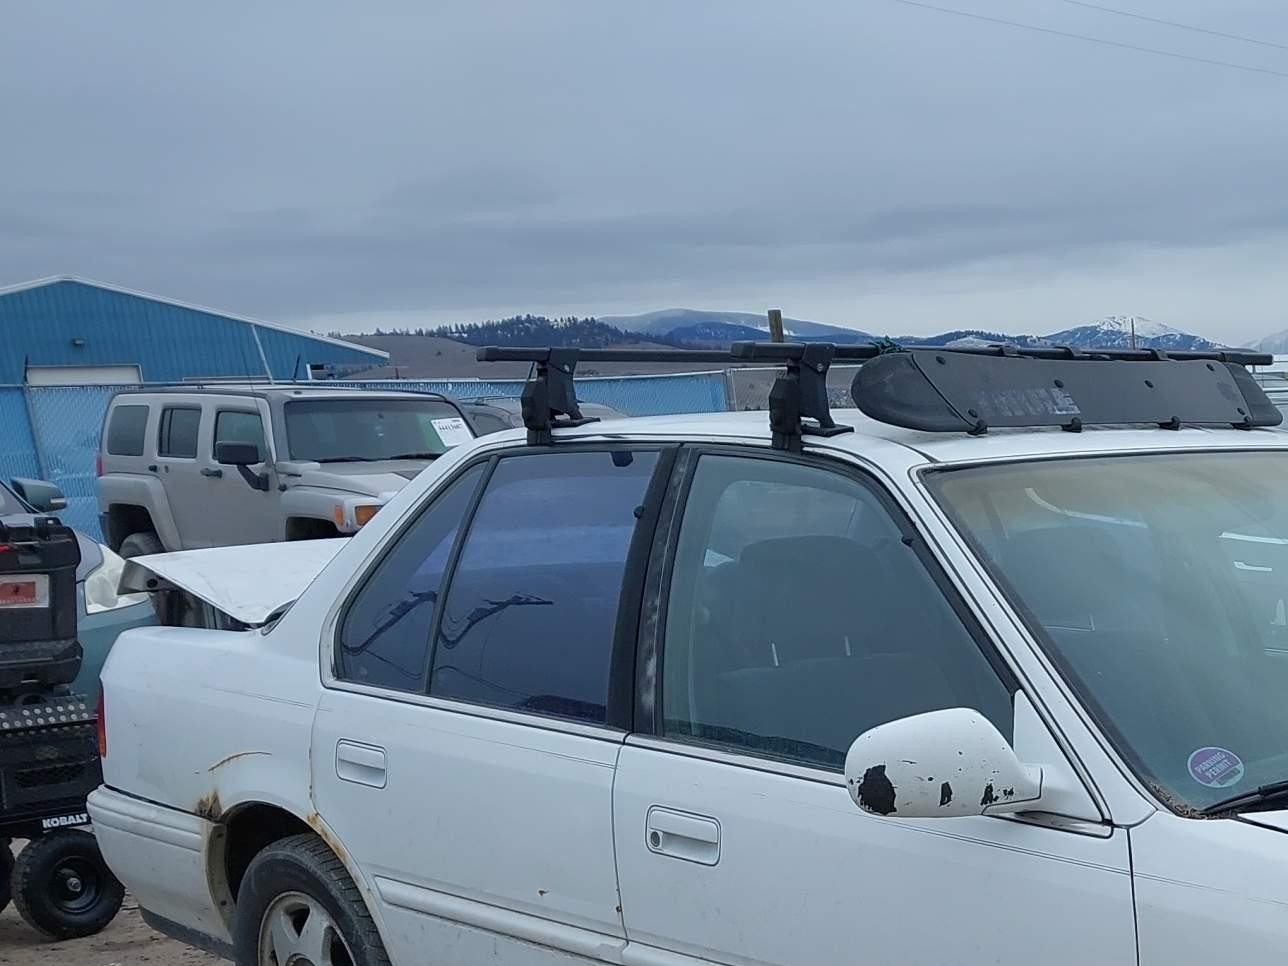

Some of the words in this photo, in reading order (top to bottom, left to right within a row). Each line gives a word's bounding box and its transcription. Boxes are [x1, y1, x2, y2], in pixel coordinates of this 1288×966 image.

[1194, 751, 1226, 775] PARKING
[1205, 759, 1233, 780] PERMIT
[41, 813, 88, 828] KOBALT
